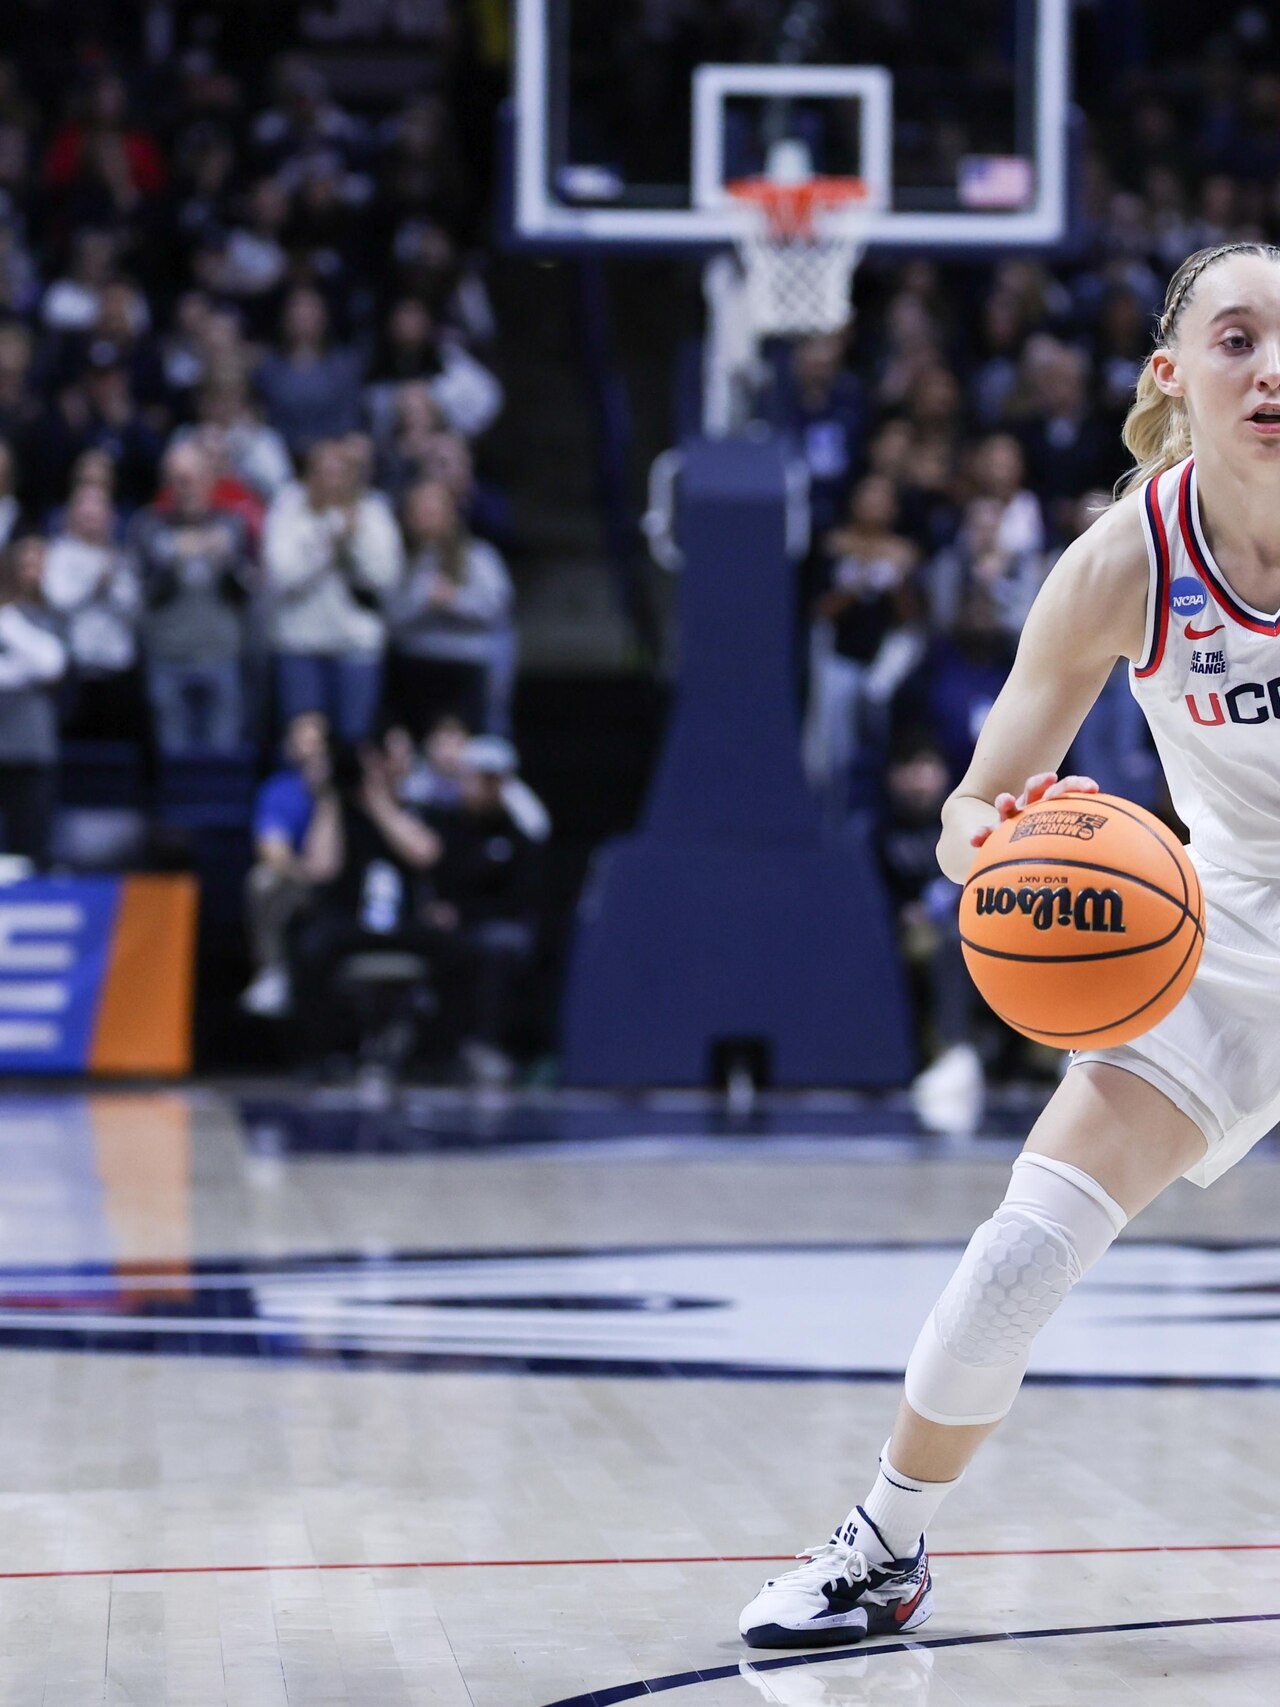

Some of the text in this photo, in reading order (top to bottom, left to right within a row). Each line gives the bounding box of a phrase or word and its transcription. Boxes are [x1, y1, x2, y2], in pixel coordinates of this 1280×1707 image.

[1172, 594, 1204, 607] NCAA
[1205, 650, 1224, 663] THE
[1032, 822, 1082, 836] MARCH
[1018, 876, 1068, 884] EVO NXT
[976, 885, 1126, 933] Wilson
